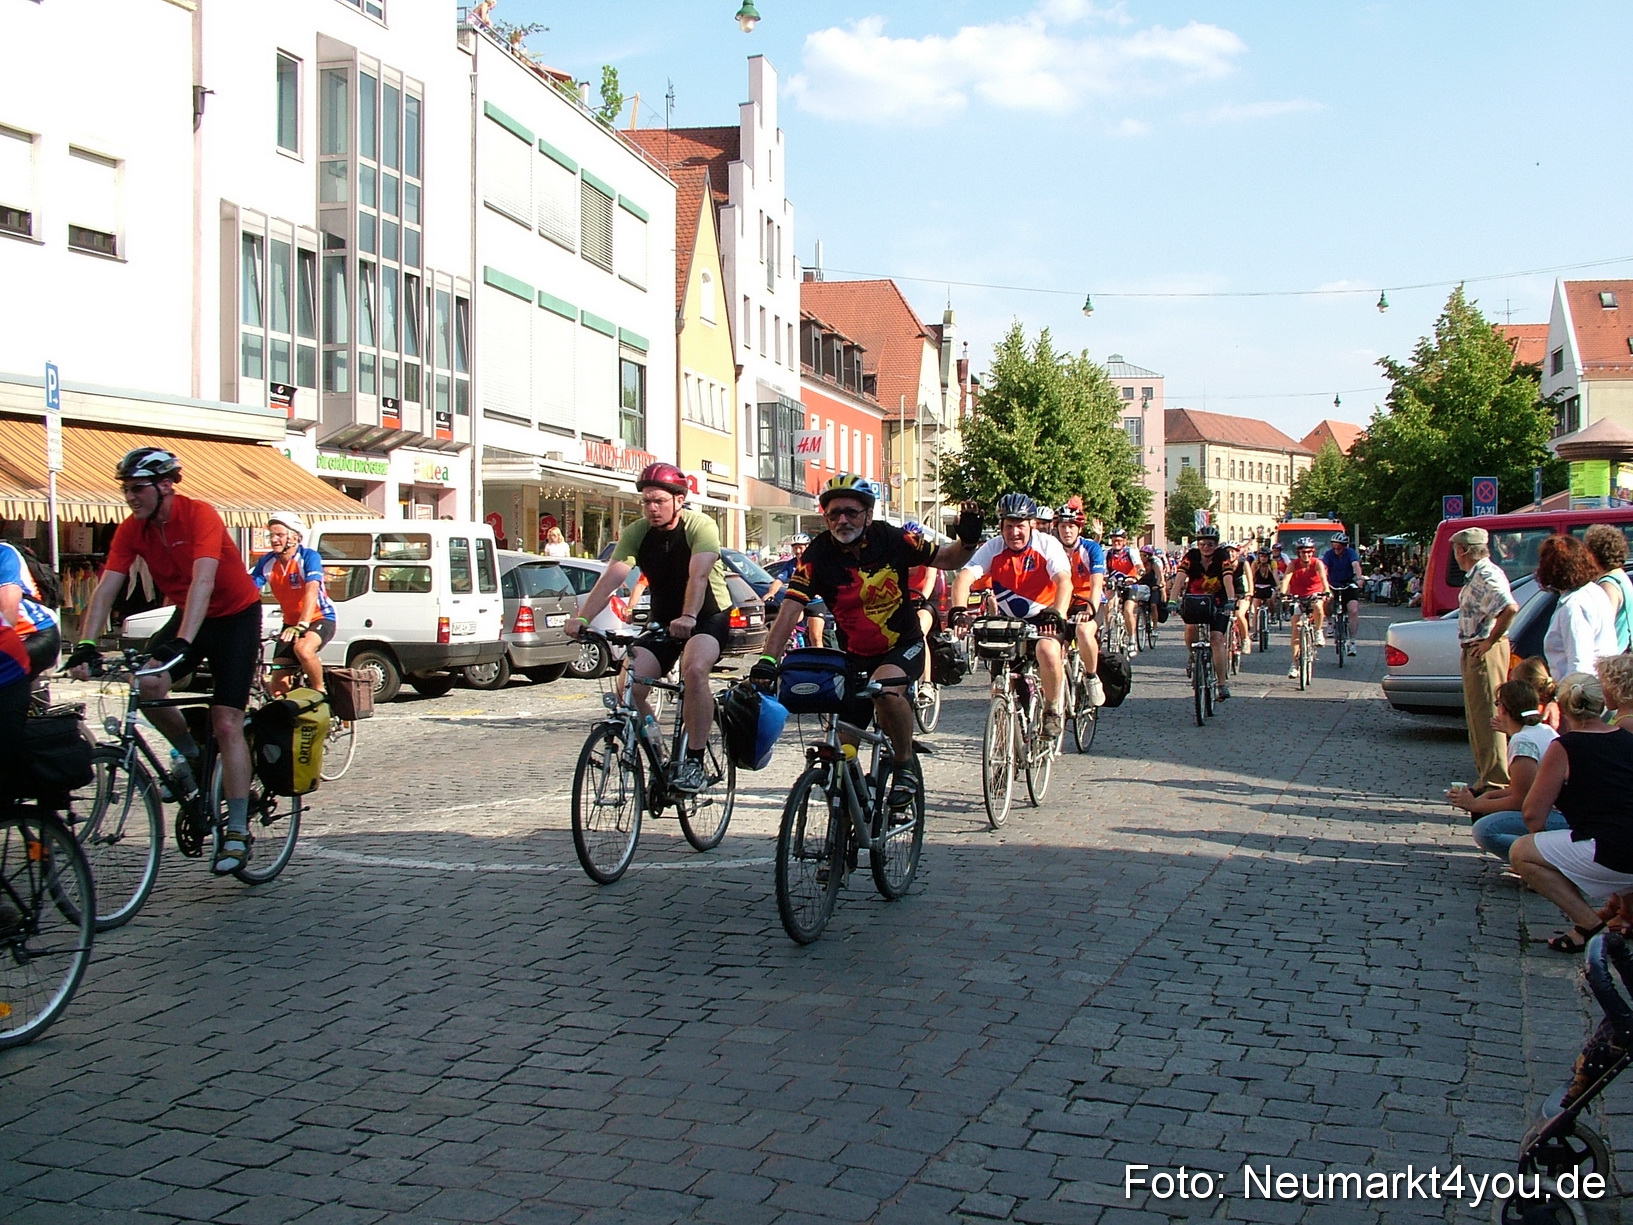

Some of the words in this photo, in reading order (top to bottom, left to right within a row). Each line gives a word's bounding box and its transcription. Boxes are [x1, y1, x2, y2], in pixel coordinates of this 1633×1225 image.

[48, 368, 57, 403] P
[797, 436, 822, 454] H&M
[1475, 505, 1495, 515] TAXI
[298, 725, 313, 765] ORTLIEB
